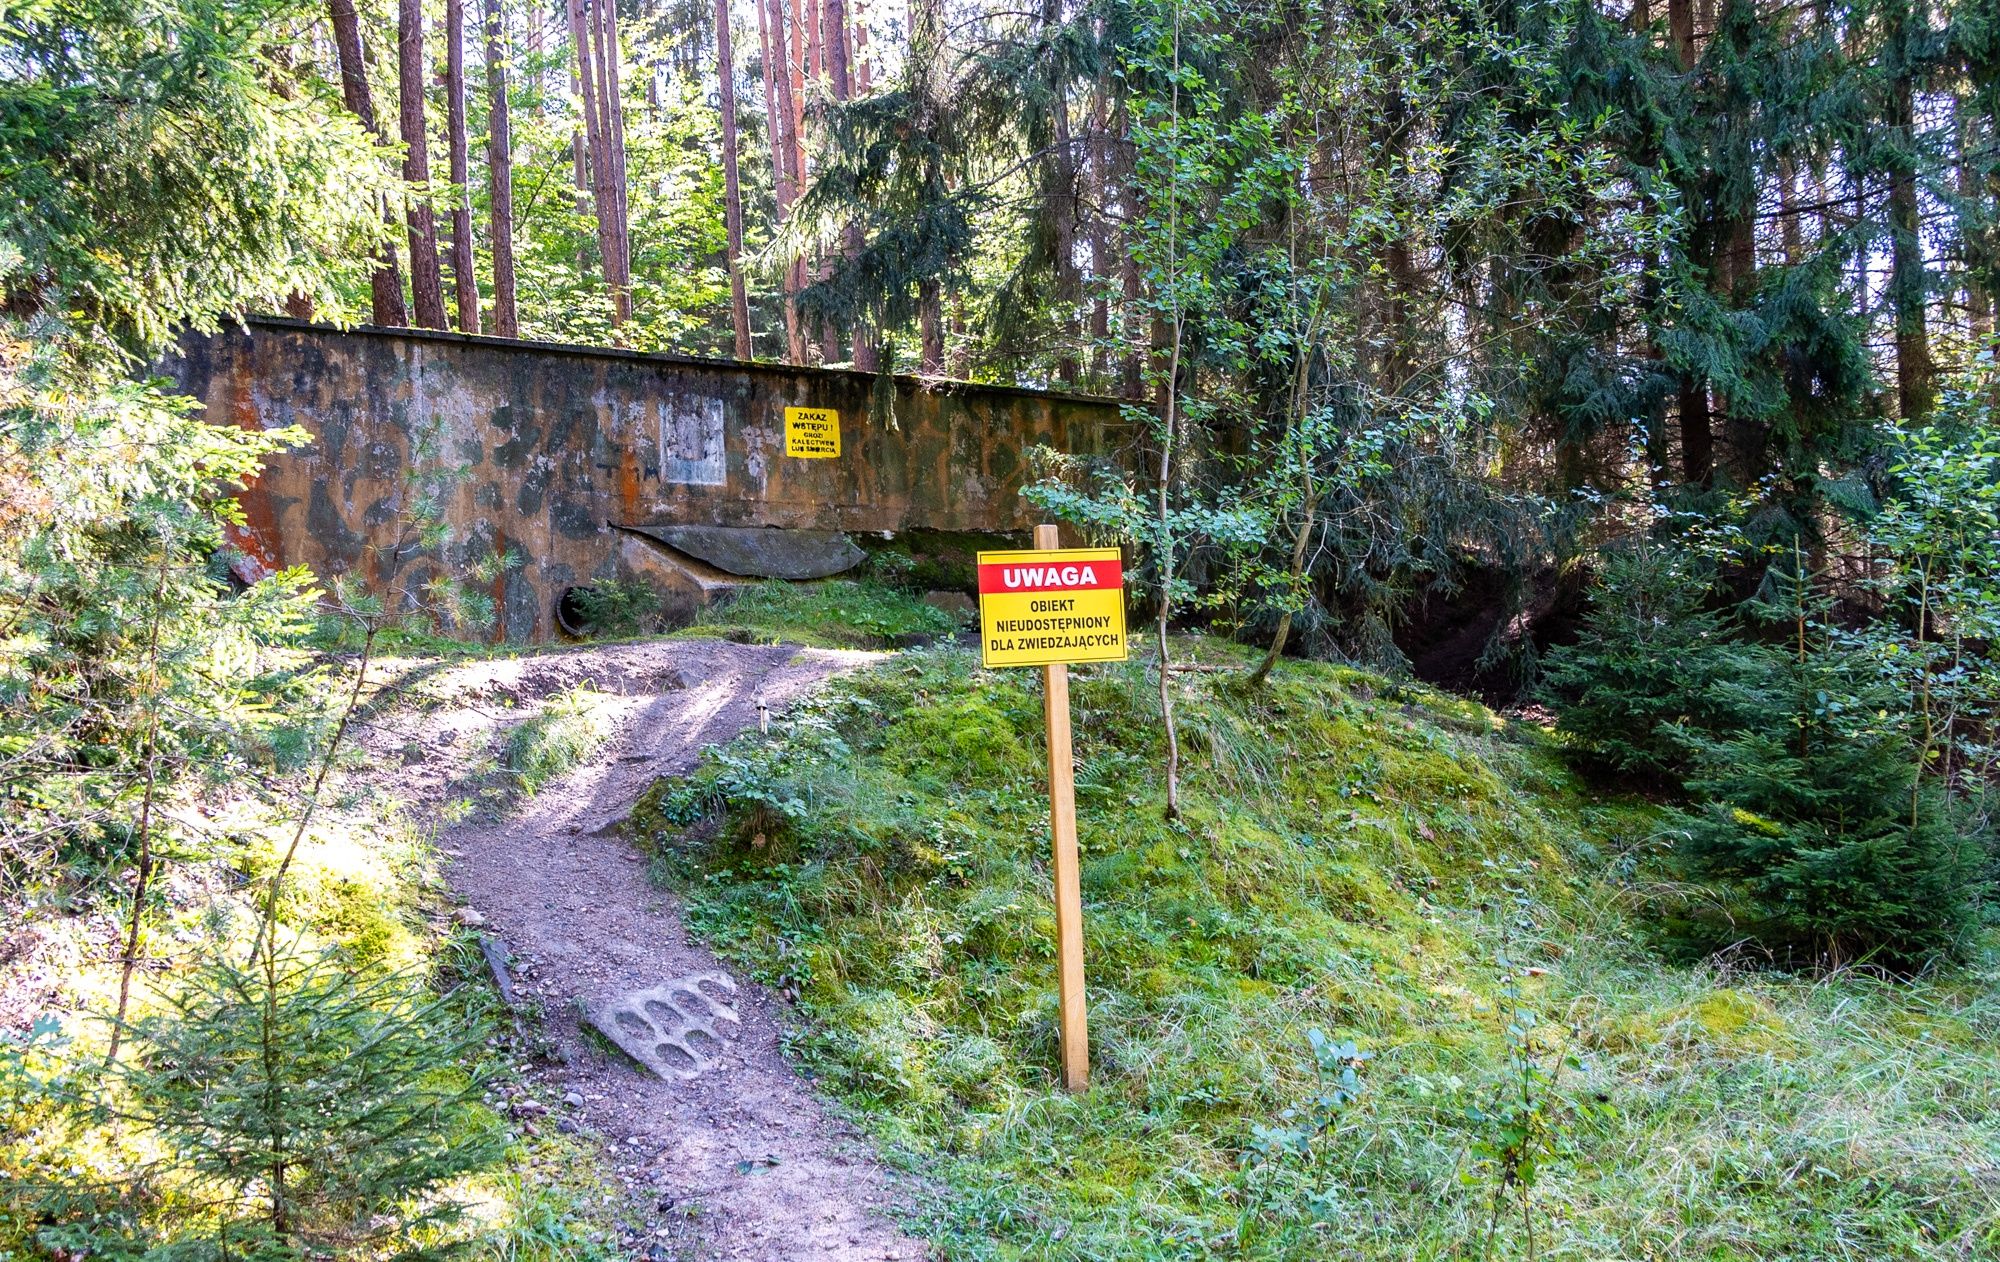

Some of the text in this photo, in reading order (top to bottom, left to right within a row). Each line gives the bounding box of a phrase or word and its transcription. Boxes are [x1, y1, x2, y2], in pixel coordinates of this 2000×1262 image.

[798, 412, 827, 421] ZAKAZ
[1003, 566, 1097, 588] UWAGA
[1030, 599, 1075, 612] OBIEKT
[996, 616, 1111, 633] NIEUDOSTĘPNIONY
[991, 634, 1119, 651] DLA ZWIEDZAJĄCYCH
